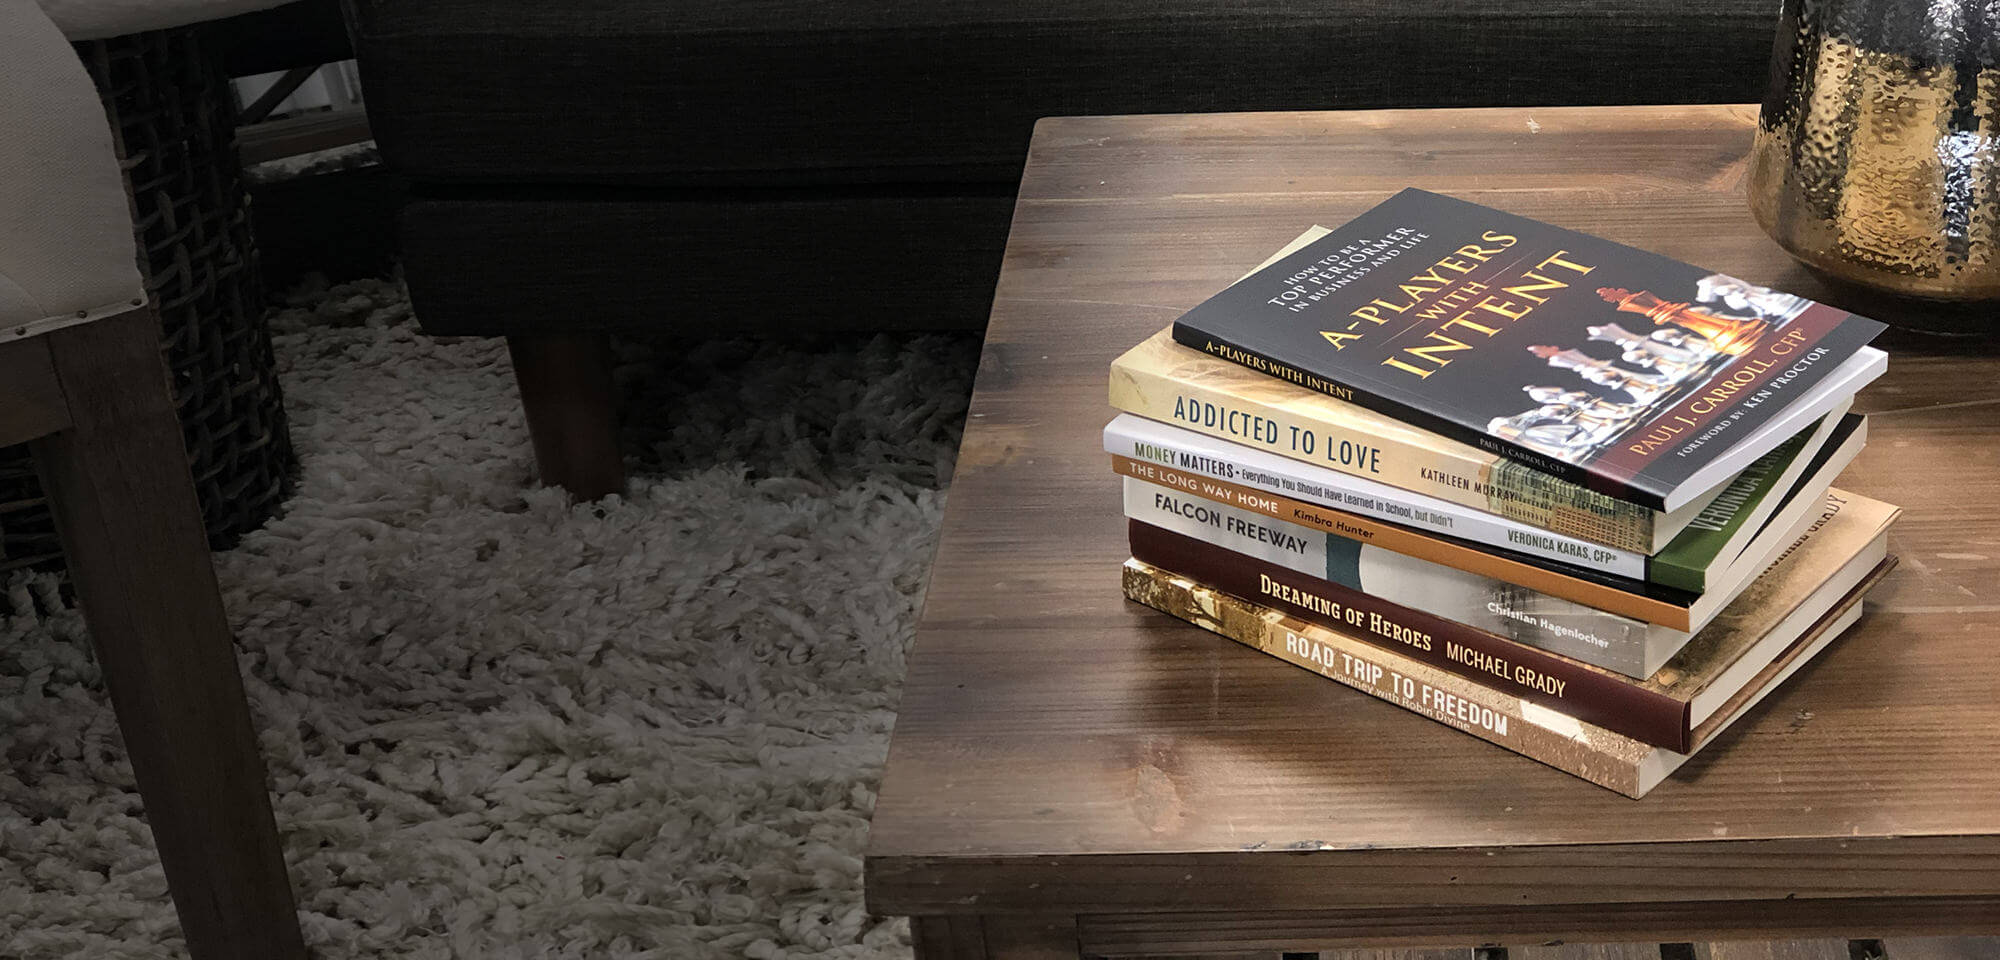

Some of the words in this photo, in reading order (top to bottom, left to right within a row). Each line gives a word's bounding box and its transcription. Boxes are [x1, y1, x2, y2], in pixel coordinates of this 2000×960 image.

[1267, 285, 1308, 306] TOP
[1308, 227, 1416, 285] PERFORMER
[1283, 265, 1319, 285] HOW
[1318, 255, 1340, 265] TO
[1340, 244, 1360, 255] BE
[1288, 300, 1310, 312] IN
[1308, 266, 1371, 301] BUSINESS
[1371, 250, 1401, 267] AND
[1400, 232, 1431, 250] LIFE
[1319, 230, 1518, 351] A-PLAYERS
[1380, 250, 1597, 380] INTENT
[1415, 281, 1490, 321] WITH
[1205, 340, 1266, 371] A-PLAYERS
[1269, 362, 1303, 384] WITH
[1307, 377, 1354, 401] INTENT
[1677, 419, 1732, 458] FOREWORD
[1743, 389, 1773, 410] KEN
[1769, 346, 1831, 390] PROCTOR
[1174, 395, 1278, 444] ADDICTED
[1289, 426, 1315, 455] TO
[1327, 436, 1381, 474] LOVE
[1629, 425, 1684, 457] PAUL
[1682, 415, 1697, 428] J.
[1690, 356, 1778, 414] CARROLL,
[1480, 438, 1499, 451] PAUL
[1129, 462, 1155, 479] THE
[1159, 470, 1198, 491] LONG
[1201, 482, 1233, 500] WAY
[1238, 492, 1279, 514] HOME
[1134, 442, 1177, 464] MONEY
[1180, 453, 1234, 479] MATTERS
[1242, 469, 1280, 488] Everything
[1281, 477, 1296, 491] You
[1297, 481, 1323, 498] Should
[1324, 488, 1343, 501] Have
[1344, 492, 1375, 510] Learned
[1376, 501, 1384, 512] in
[1385, 503, 1414, 520] School,
[1415, 510, 1428, 522] but
[1430, 512, 1454, 528] Didn't
[1421, 467, 1470, 490] KATHLEEN
[1474, 482, 1515, 503] MURRAY
[1155, 492, 1221, 528] FALCON
[1227, 516, 1308, 555] FREEWAY
[1293, 508, 1332, 529] Kimbra
[1335, 520, 1375, 540] Hunter
[1507, 529, 1555, 552] VERONICA
[1557, 541, 1591, 561] KARAS,
[1260, 573, 1342, 621] DREAMING
[1345, 608, 1365, 628] OF
[1369, 611, 1433, 652] HEROES
[1487, 601, 1537, 626] Christian
[1540, 618, 1609, 648] Hagenlocher
[1285, 632, 1335, 670] ROAD
[1342, 654, 1384, 684] TRIP
[1391, 671, 1415, 700] TO
[1422, 690, 1508, 737] FREEDOM
[1320, 666, 1328, 676] A
[1330, 670, 1375, 695] Journey
[1376, 687, 1400, 705] with
[1401, 700, 1433, 717] Robin
[1435, 710, 1471, 732] Divine
[1446, 640, 1512, 681] MICHAEL
[1515, 666, 1567, 699] GRADY
